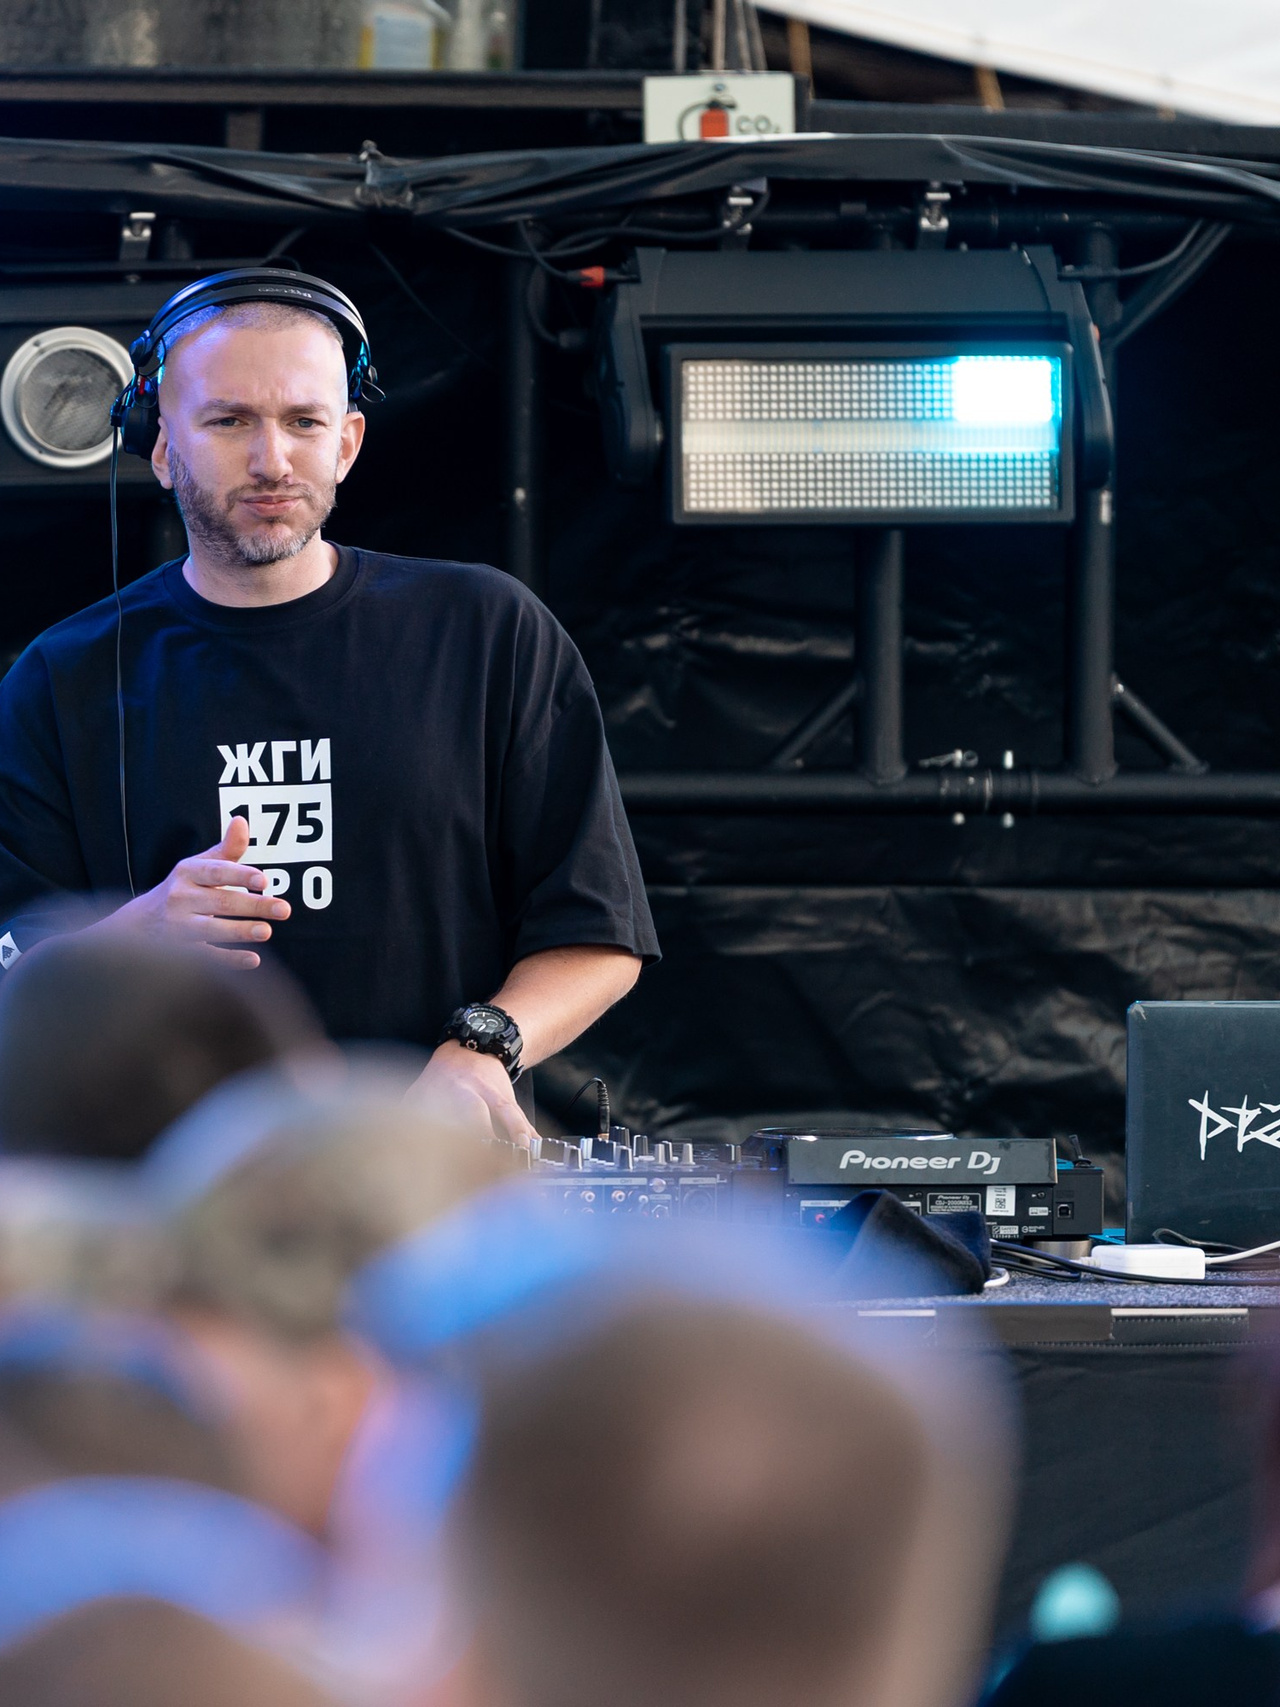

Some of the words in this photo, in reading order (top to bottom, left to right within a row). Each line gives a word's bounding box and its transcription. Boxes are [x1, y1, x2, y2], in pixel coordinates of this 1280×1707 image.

[216, 738, 331, 784] ЖГИ
[219, 866, 333, 910] РО
[839, 1149, 961, 1170] Pioneer
